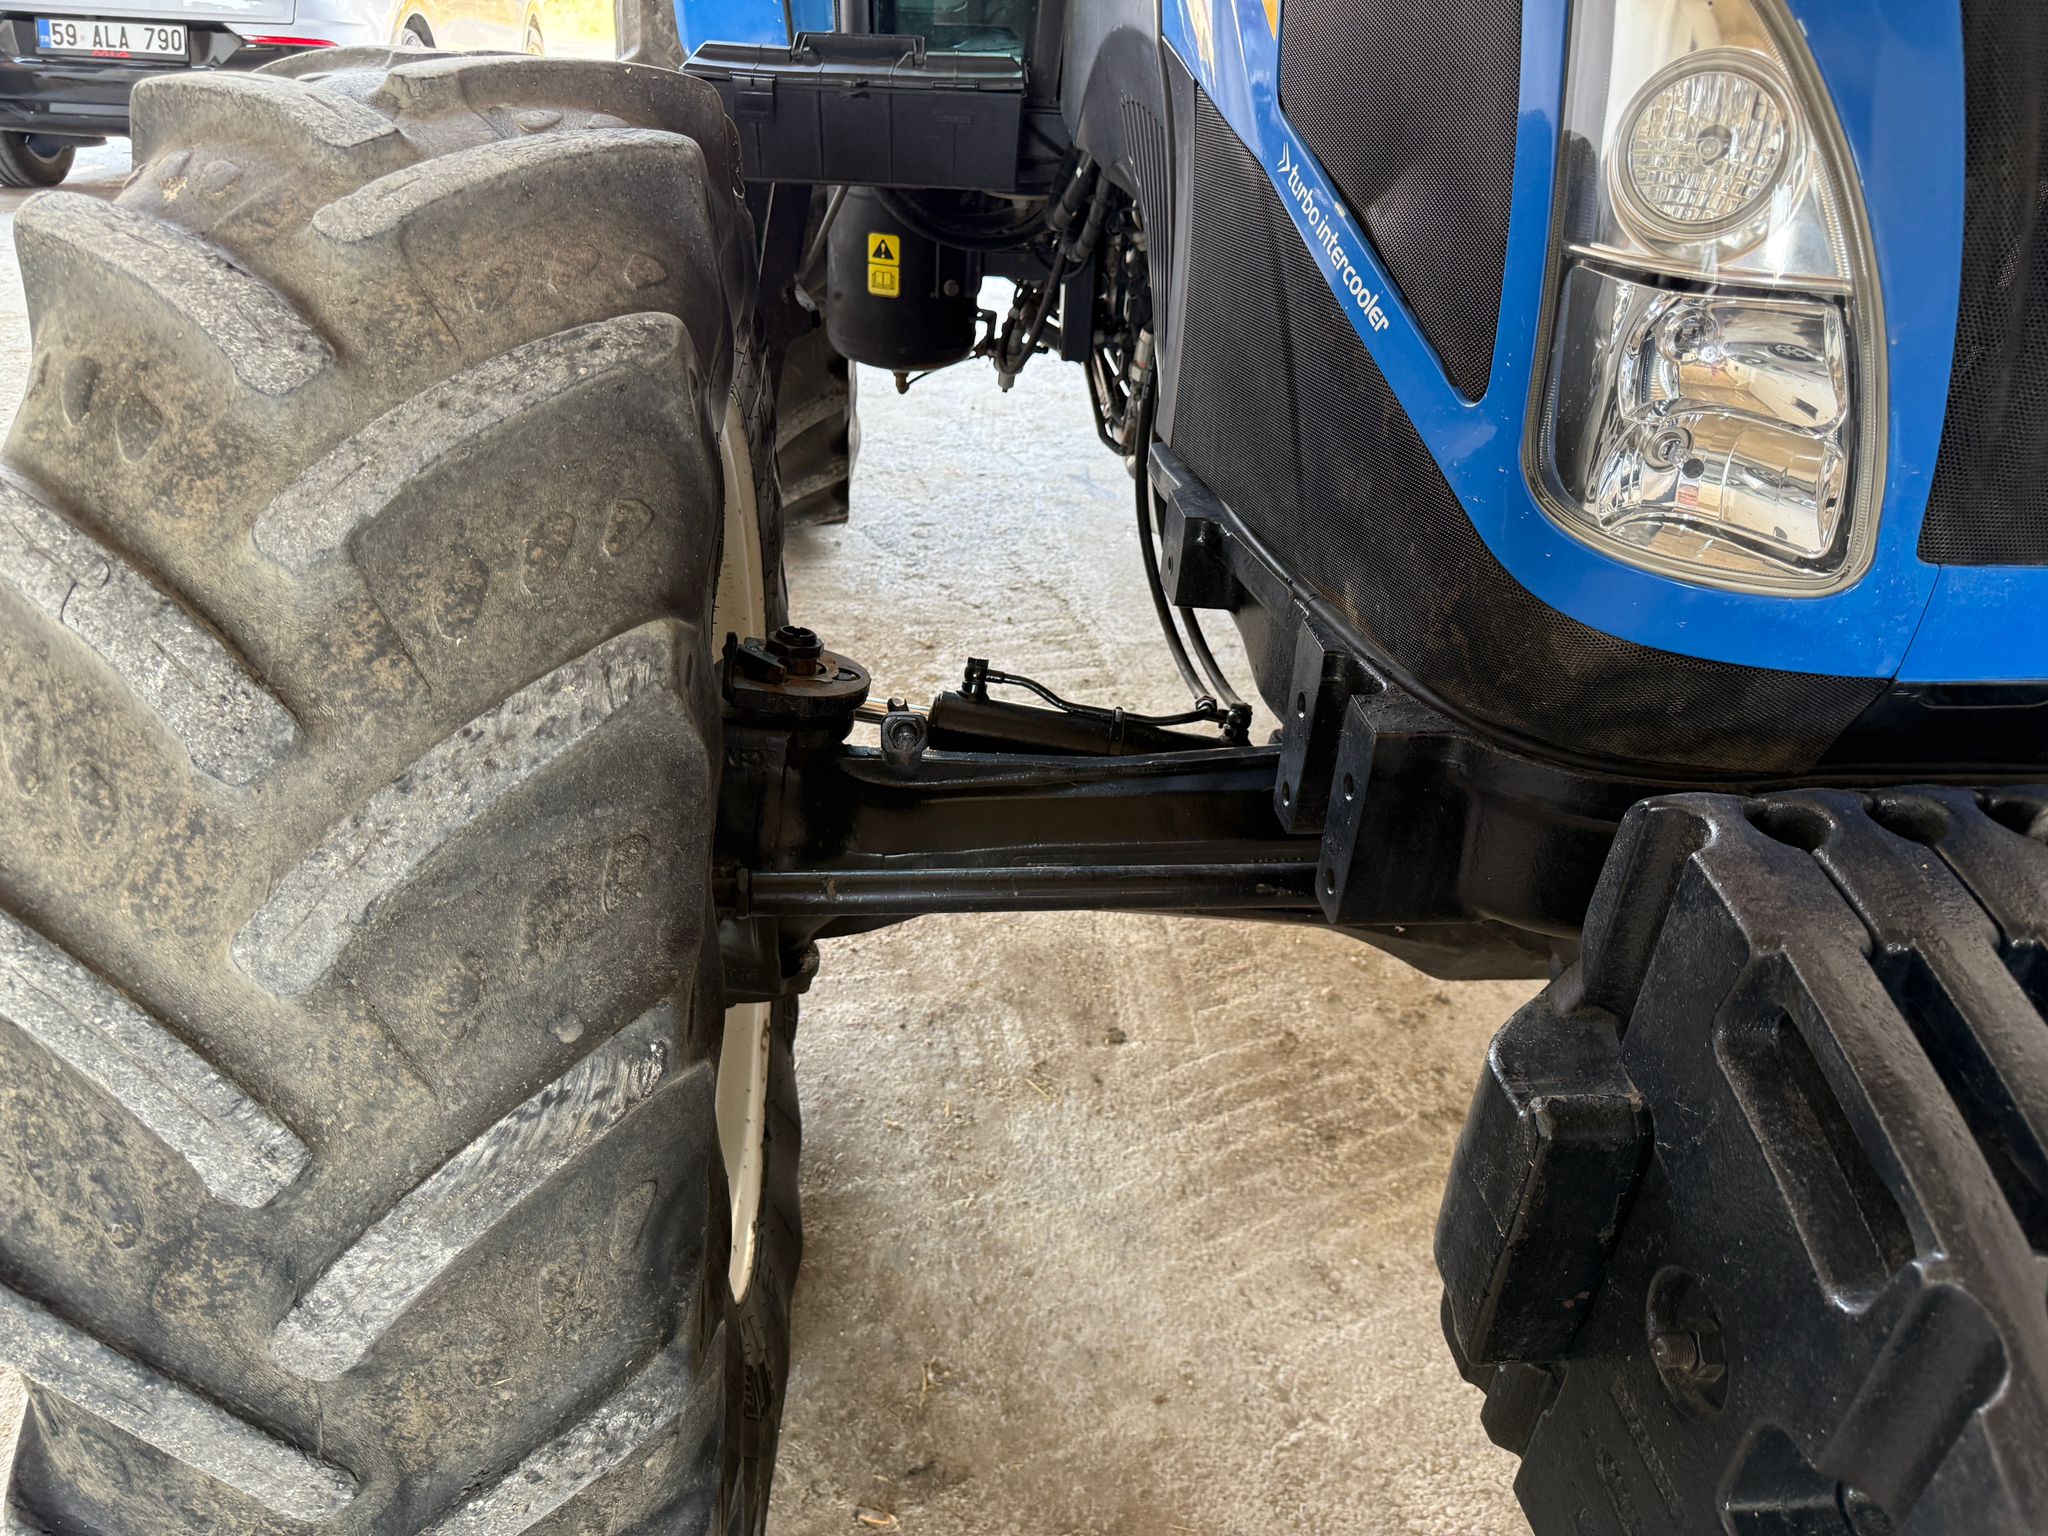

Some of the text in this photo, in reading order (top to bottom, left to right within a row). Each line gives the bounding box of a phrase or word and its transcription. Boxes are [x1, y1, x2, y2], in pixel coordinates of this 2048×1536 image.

[40, 35, 50, 43] TR
[52, 23, 182, 51] 59 ALA 790
[1287, 163, 1390, 332] turbo intercooler
